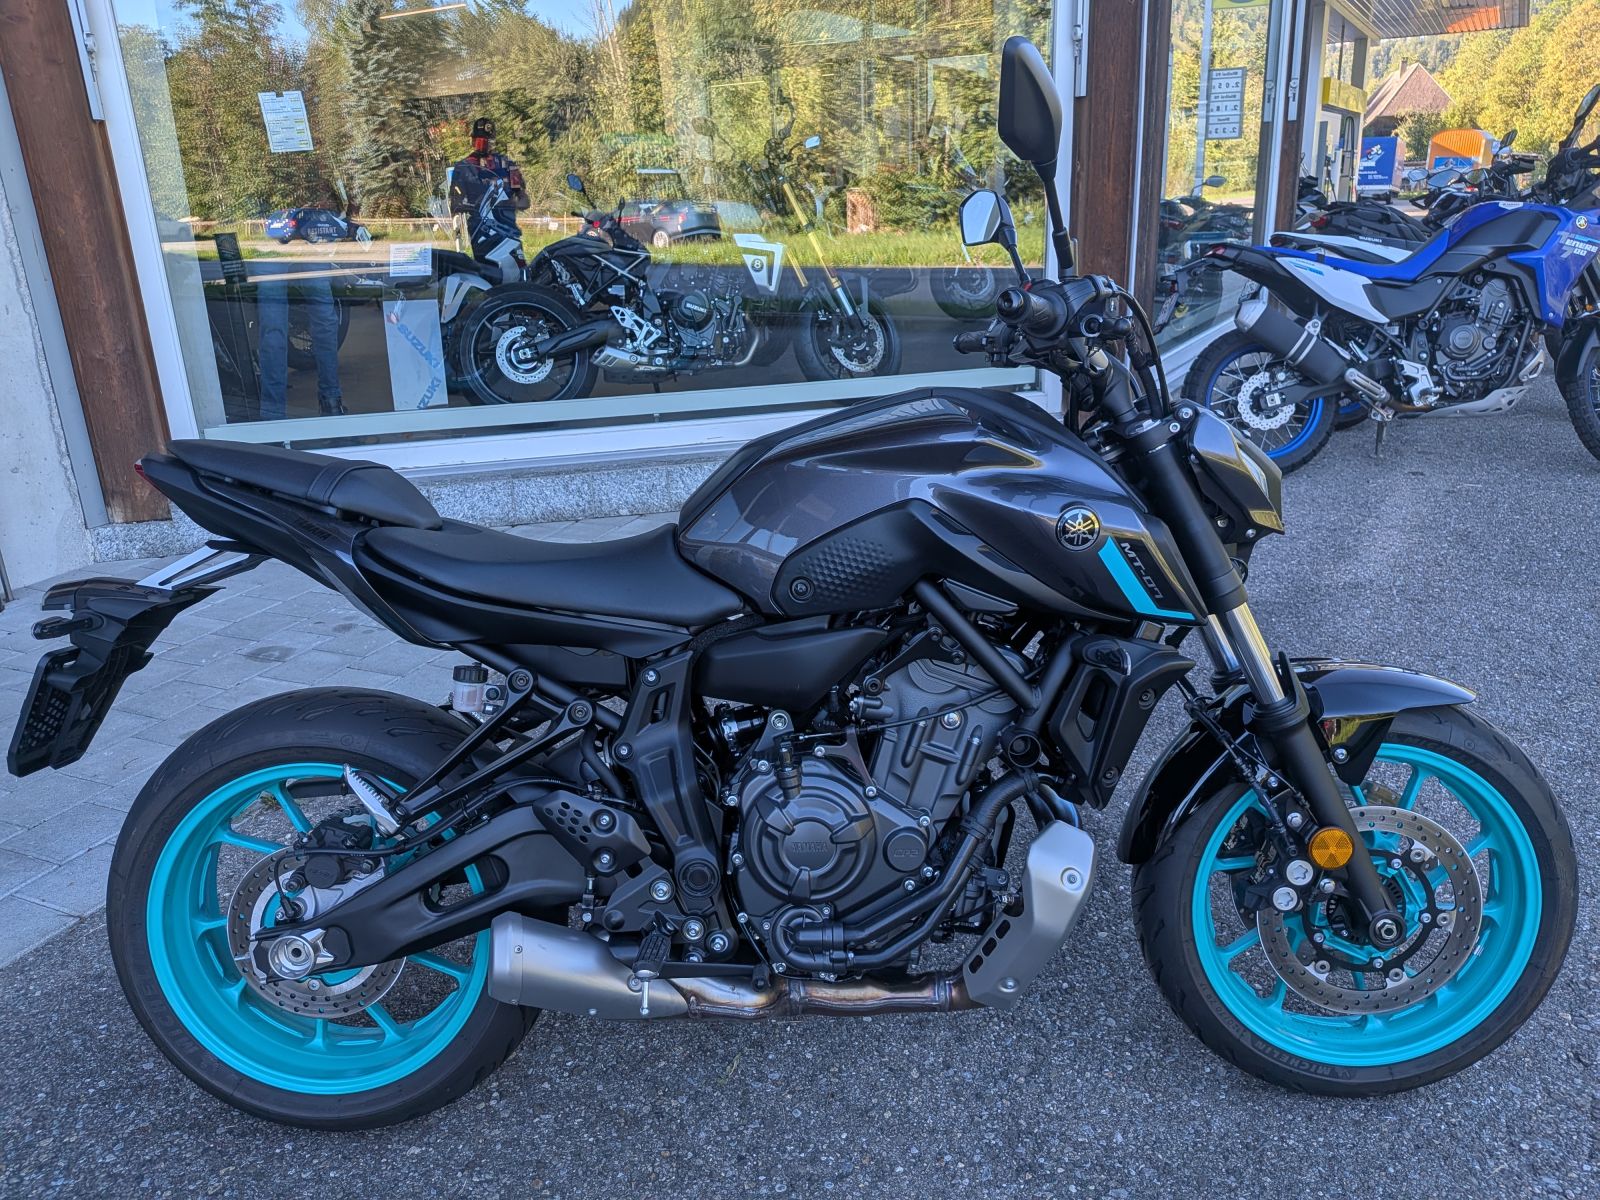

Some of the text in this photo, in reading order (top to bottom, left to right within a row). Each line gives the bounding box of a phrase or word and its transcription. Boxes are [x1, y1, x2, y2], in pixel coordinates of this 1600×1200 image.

[685, 302, 707, 313] SUZUKI
[397, 323, 441, 369] SUZUKI
[1120, 542, 1164, 599] MT-07
[791, 841, 828, 853] YAMAHA
[1254, 1038, 1332, 1077] MICHELIN
